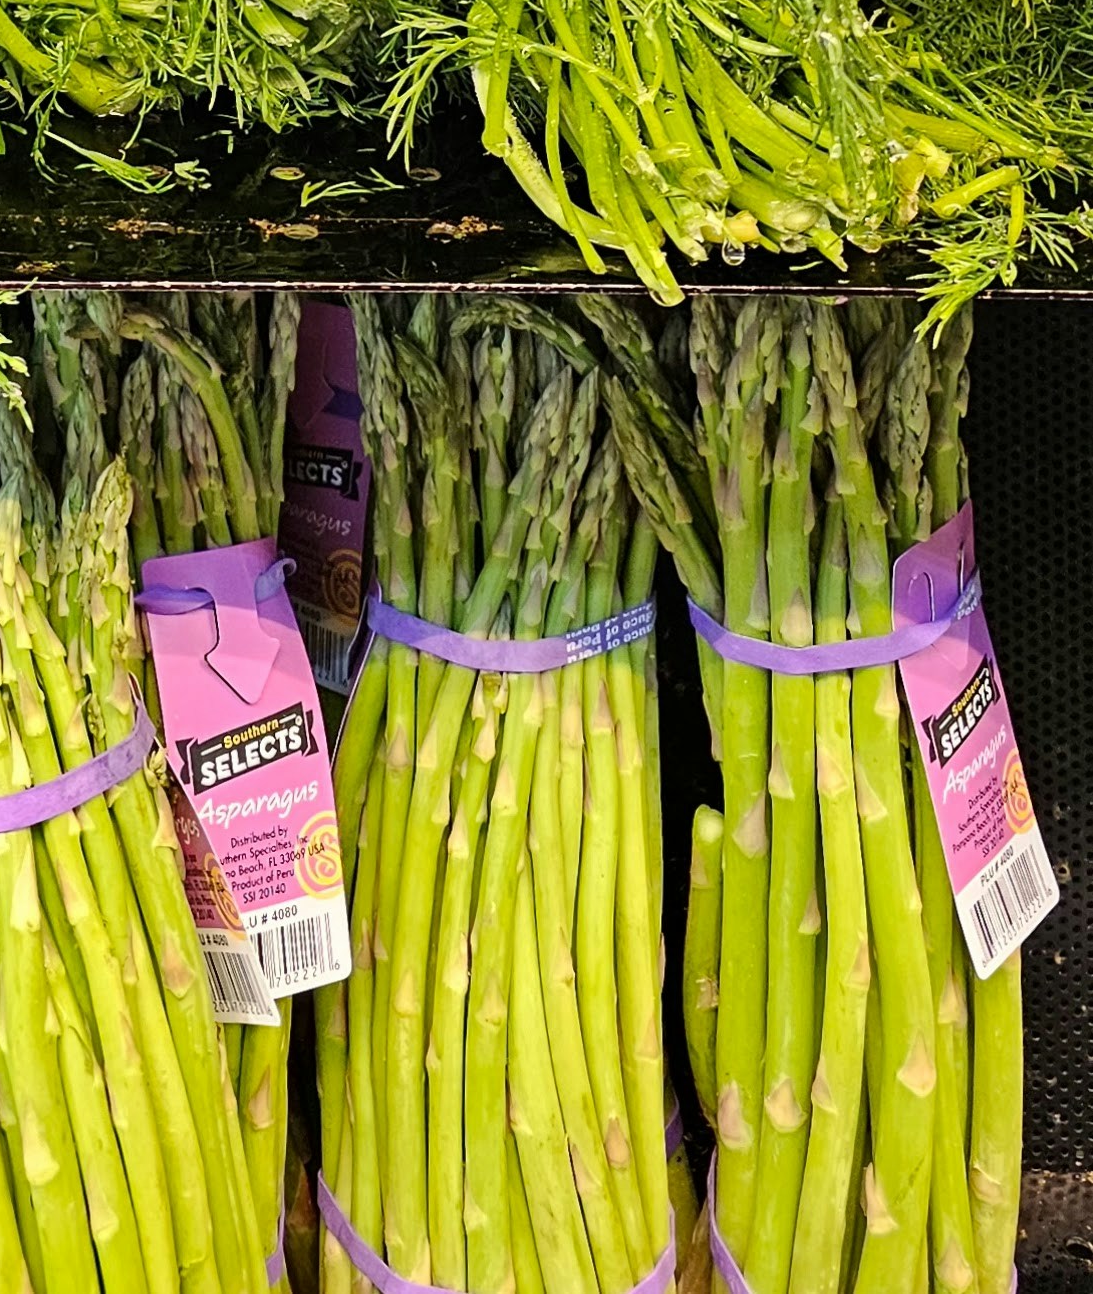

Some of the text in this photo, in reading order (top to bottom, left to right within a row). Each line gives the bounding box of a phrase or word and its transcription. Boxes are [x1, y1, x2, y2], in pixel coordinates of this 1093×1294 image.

[566, 632, 601, 652] Peru
[951, 677, 981, 717] Southern
[223, 719, 279, 749] Southern
[943, 724, 1007, 804] Asparagus
[199, 780, 319, 829] Asparagus
[231, 825, 288, 849] Distributed by
[220, 851, 247, 865] uthern
[238, 860, 266, 876] Beach,
[268, 857, 277, 868] FL
[280, 847, 306, 865] 33069
[308, 842, 325, 857] USA
[231, 876, 264, 892] Product
[265, 873, 274, 883] of
[276, 869, 295, 881] Peru
[243, 883, 287, 904] SSI 20140
[271, 904, 298, 921] 4080
